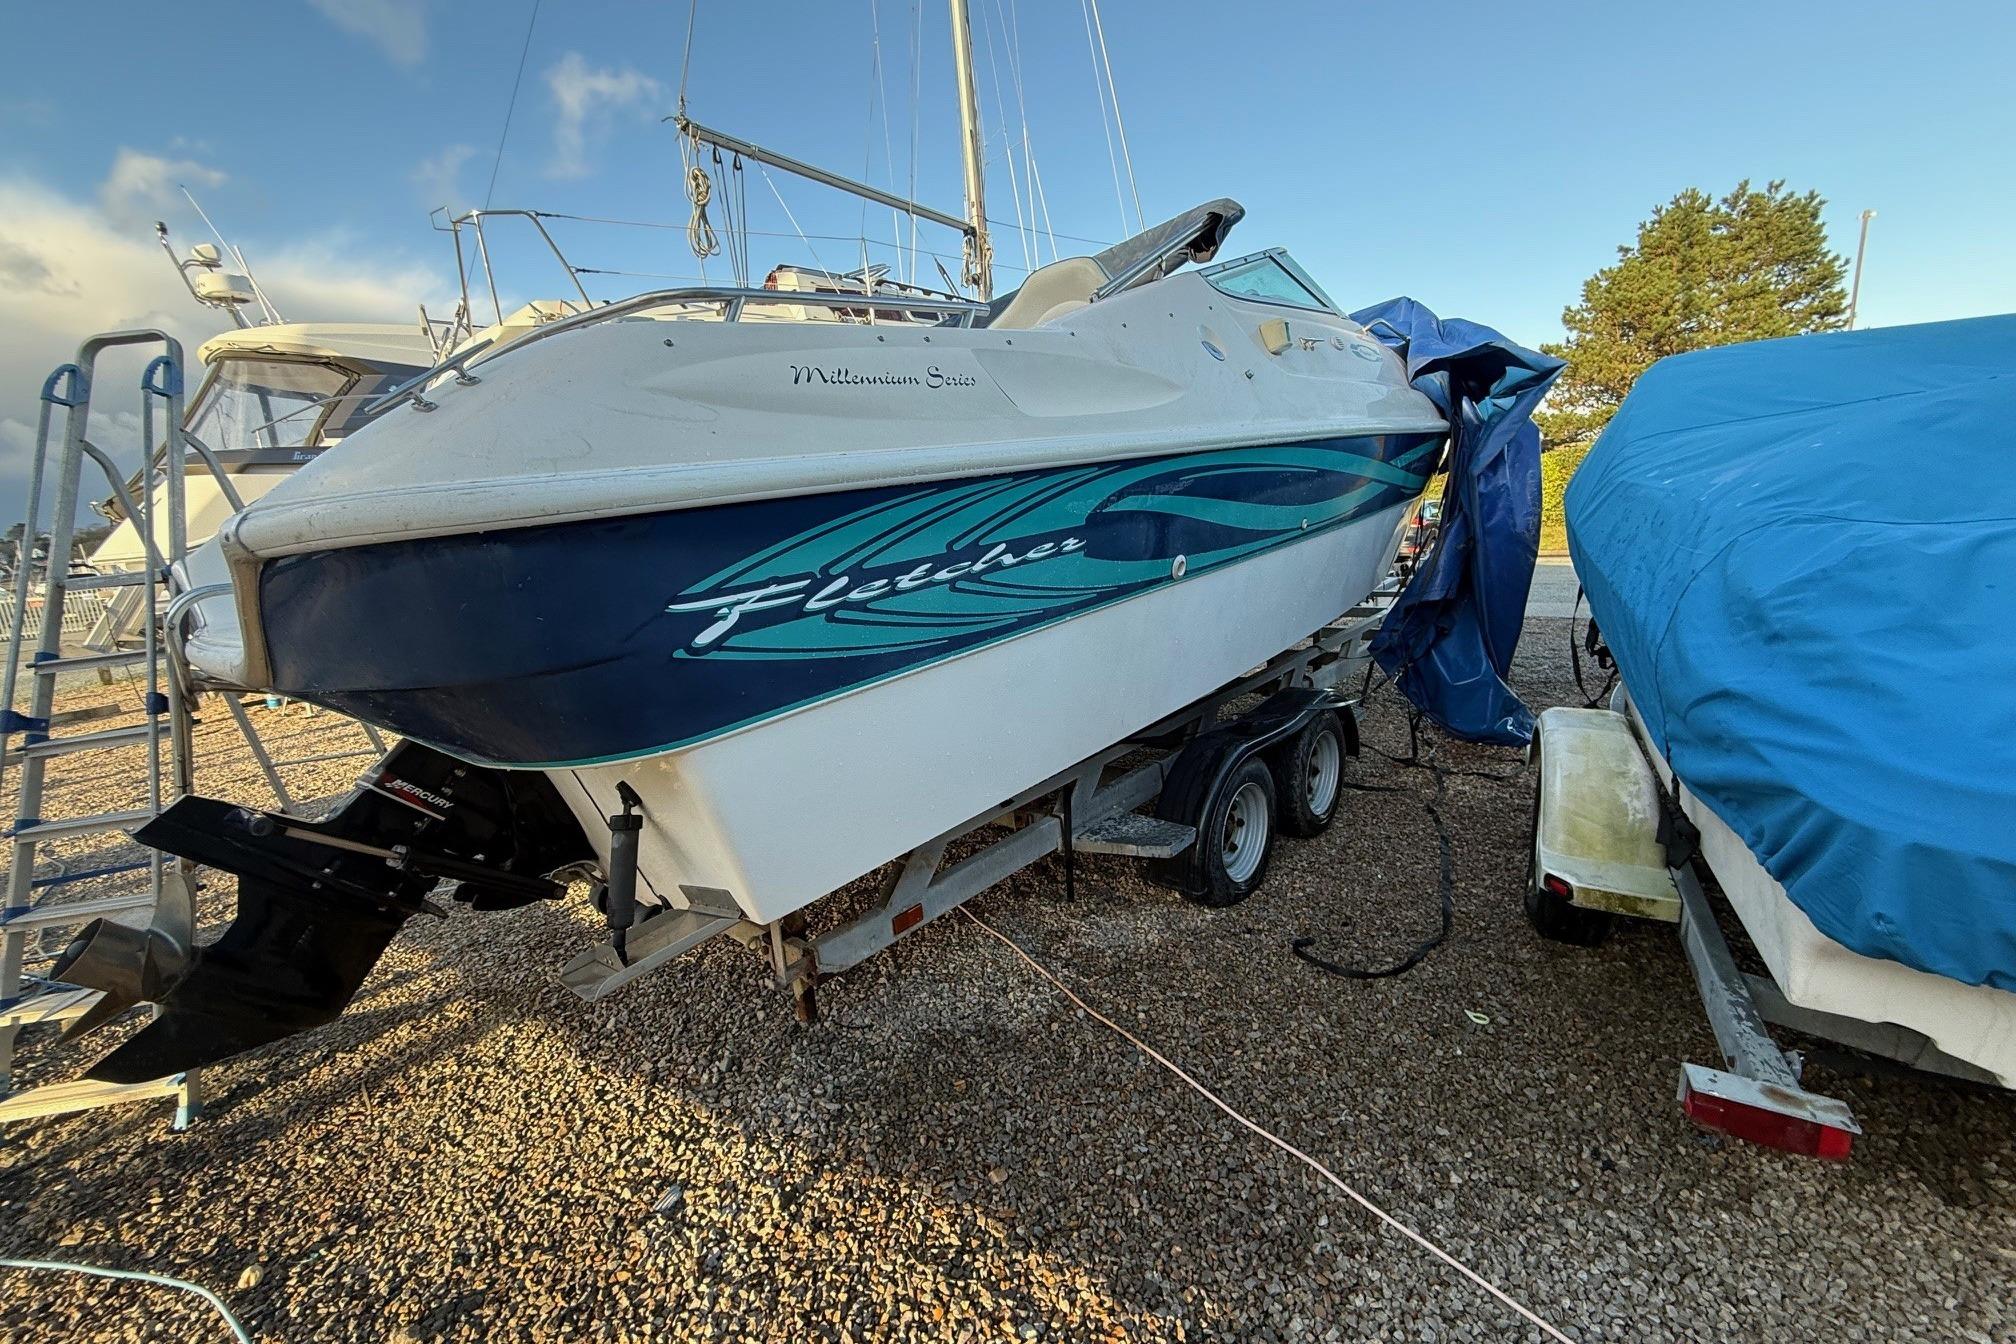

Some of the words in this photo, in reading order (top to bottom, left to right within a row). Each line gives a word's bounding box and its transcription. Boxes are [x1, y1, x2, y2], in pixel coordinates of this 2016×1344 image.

[790, 365, 920, 385] Millennium
[925, 365, 976, 389] Series
[666, 536, 1087, 647] Fletcher
[390, 779, 455, 809] MERCURY
